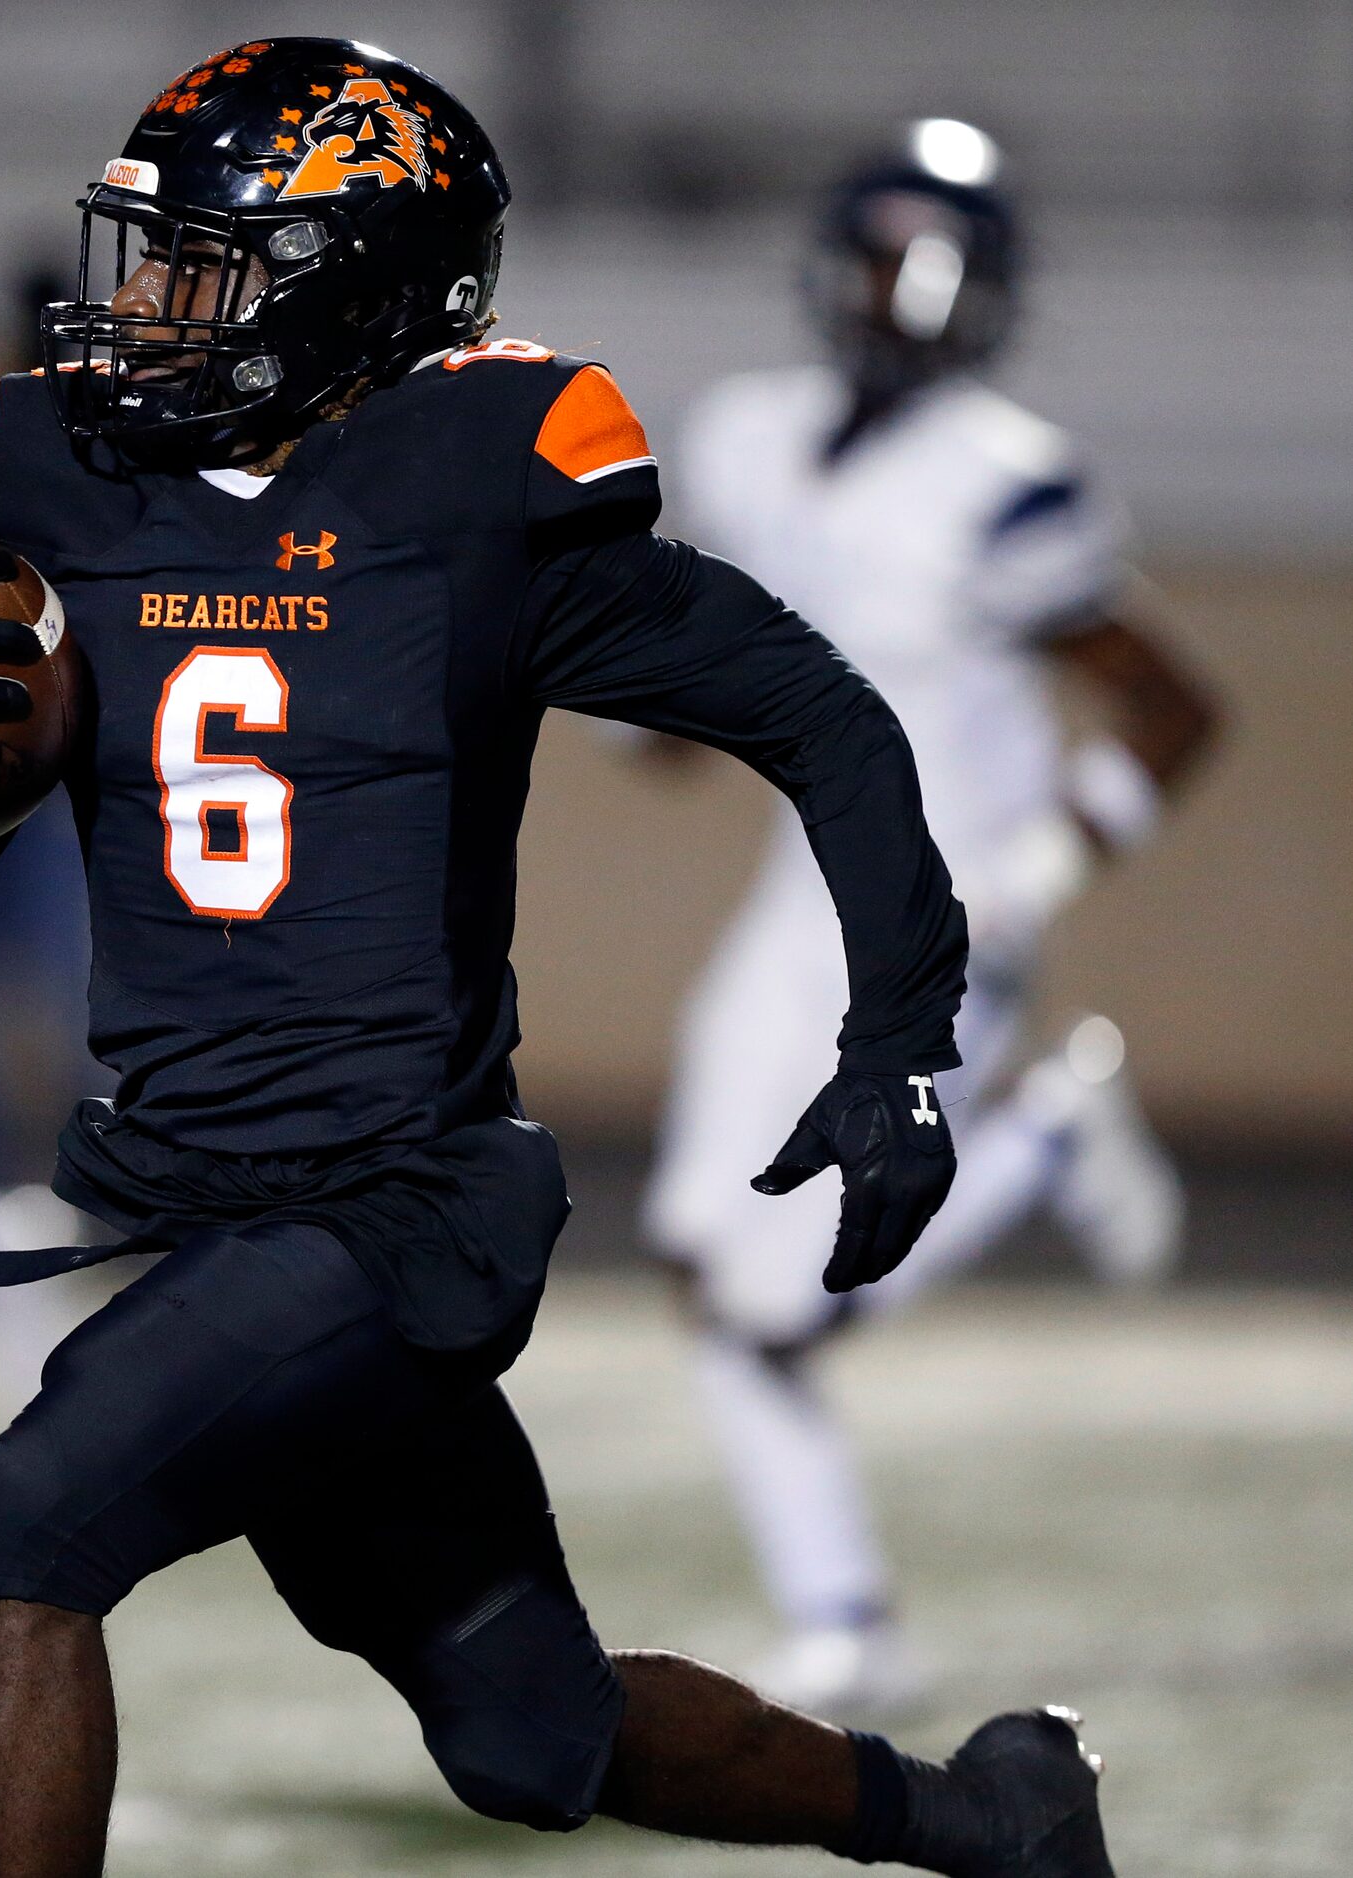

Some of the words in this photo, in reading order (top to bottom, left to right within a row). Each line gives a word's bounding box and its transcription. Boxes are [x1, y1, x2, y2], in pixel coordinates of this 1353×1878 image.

[456, 282, 477, 310] T
[139, 593, 329, 631] BEARCATS
[152, 645, 294, 919] 6
